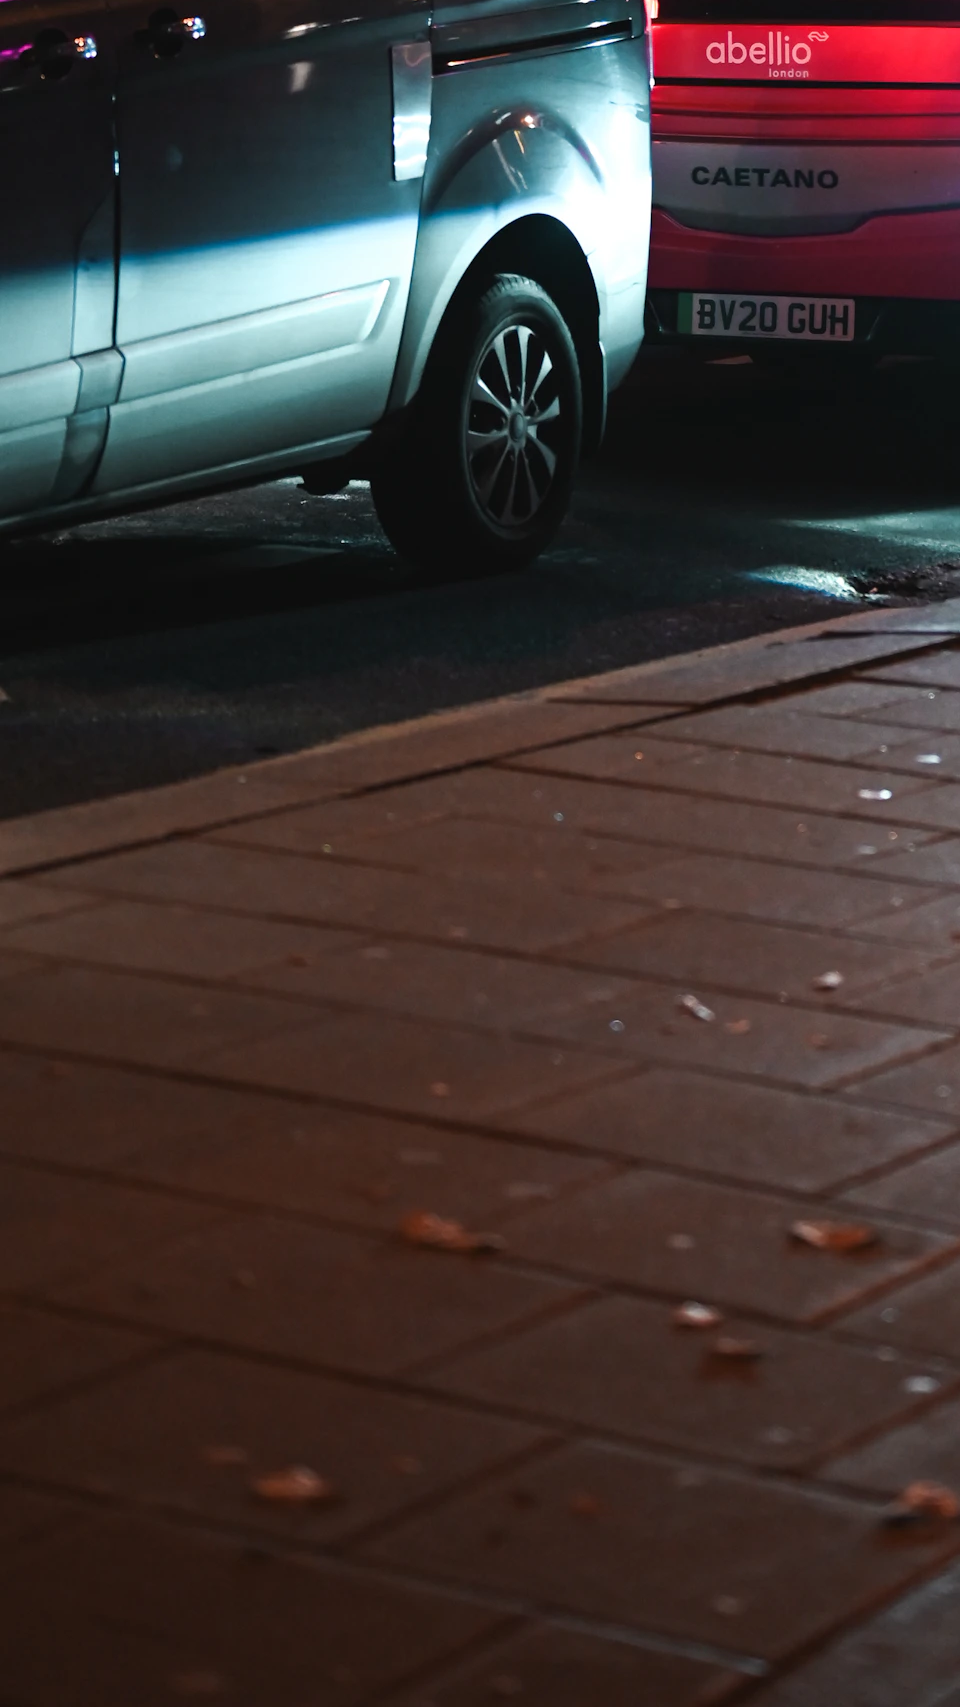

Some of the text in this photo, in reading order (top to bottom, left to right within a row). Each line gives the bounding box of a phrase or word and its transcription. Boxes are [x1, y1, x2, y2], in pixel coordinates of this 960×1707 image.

[706, 30, 812, 66] abellio
[768, 68, 809, 79] london
[691, 166, 839, 189] CAETANO
[697, 299, 849, 336] BV20 GUH
